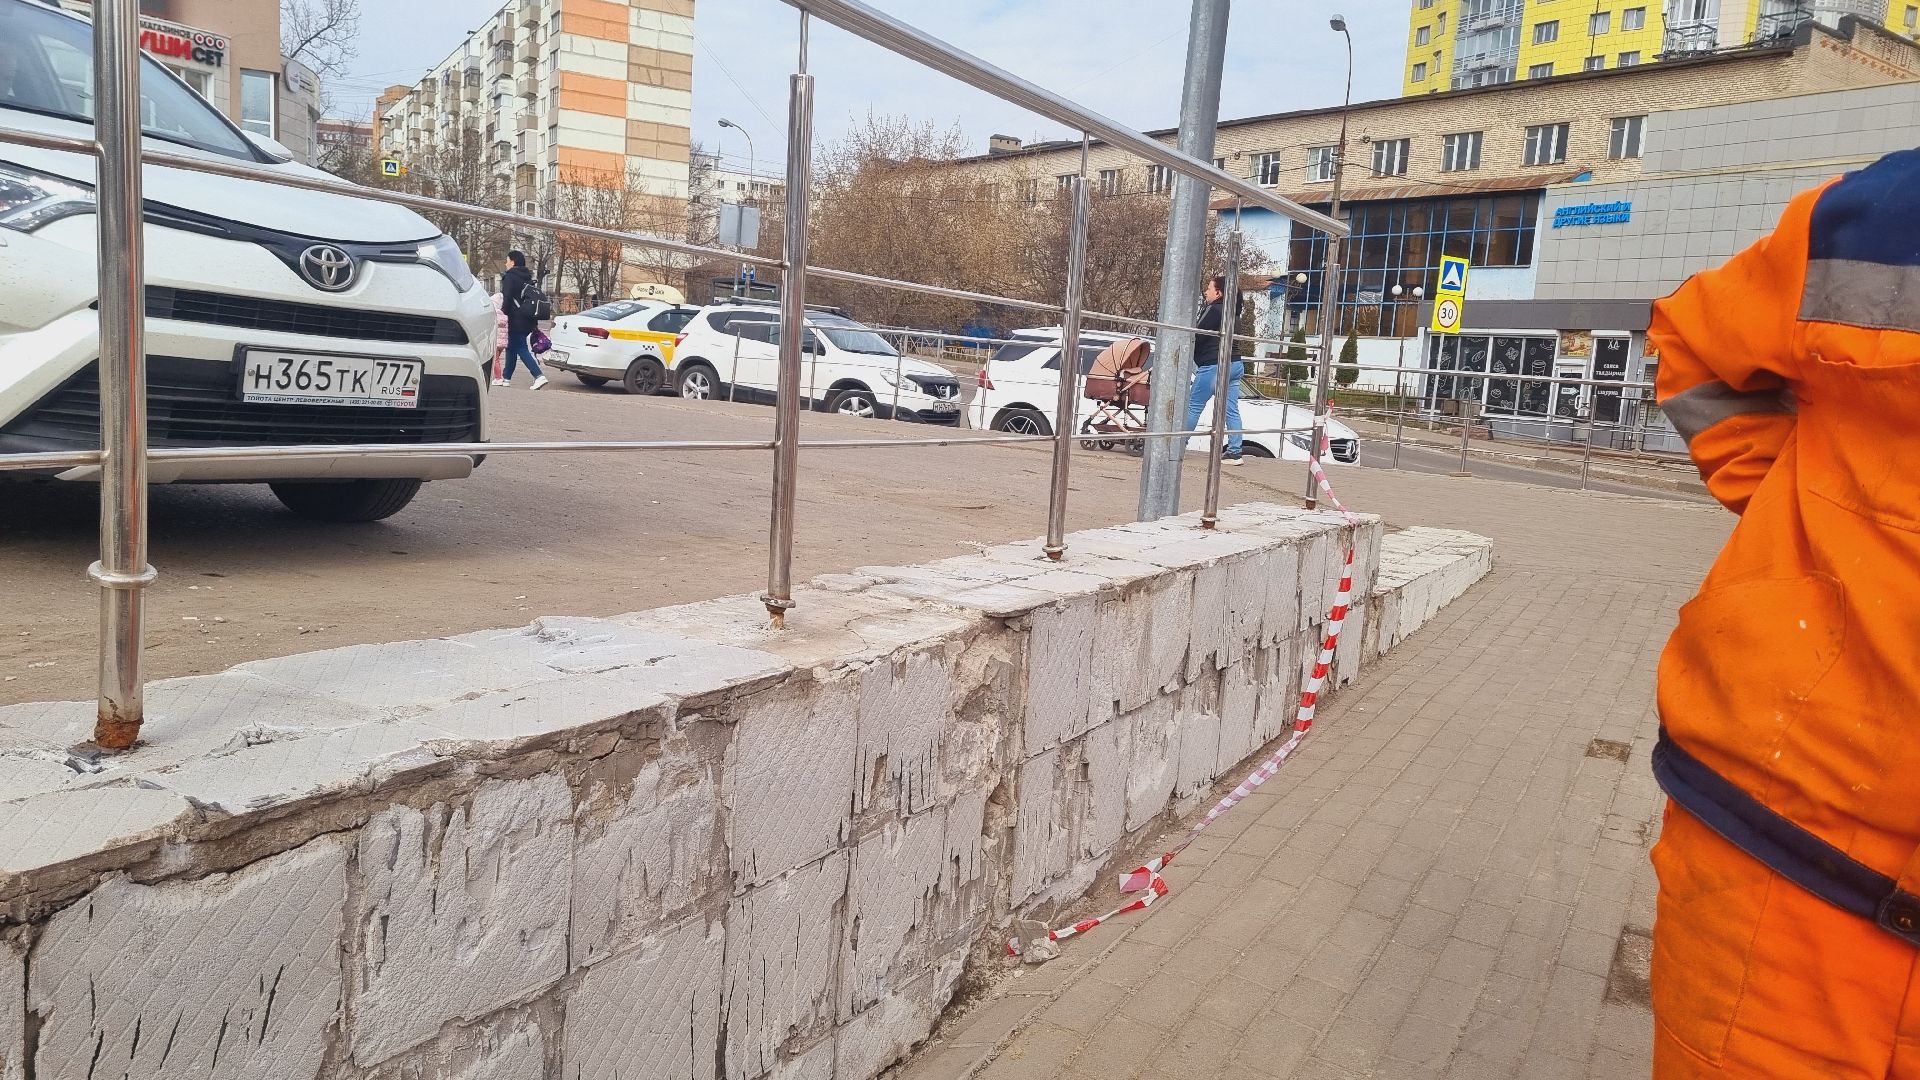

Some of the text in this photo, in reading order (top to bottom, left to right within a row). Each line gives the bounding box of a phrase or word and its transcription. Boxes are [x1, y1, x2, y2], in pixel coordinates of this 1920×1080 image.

[1555, 201, 1620, 216] АНГЛИЙСКИЙ
[1552, 213, 1631, 228] ДРУГИЕ ЯЗЫКИ
[1441, 307, 1454, 319] 30
[376, 362, 414, 386] 777
[381, 387, 401, 395] RUS
